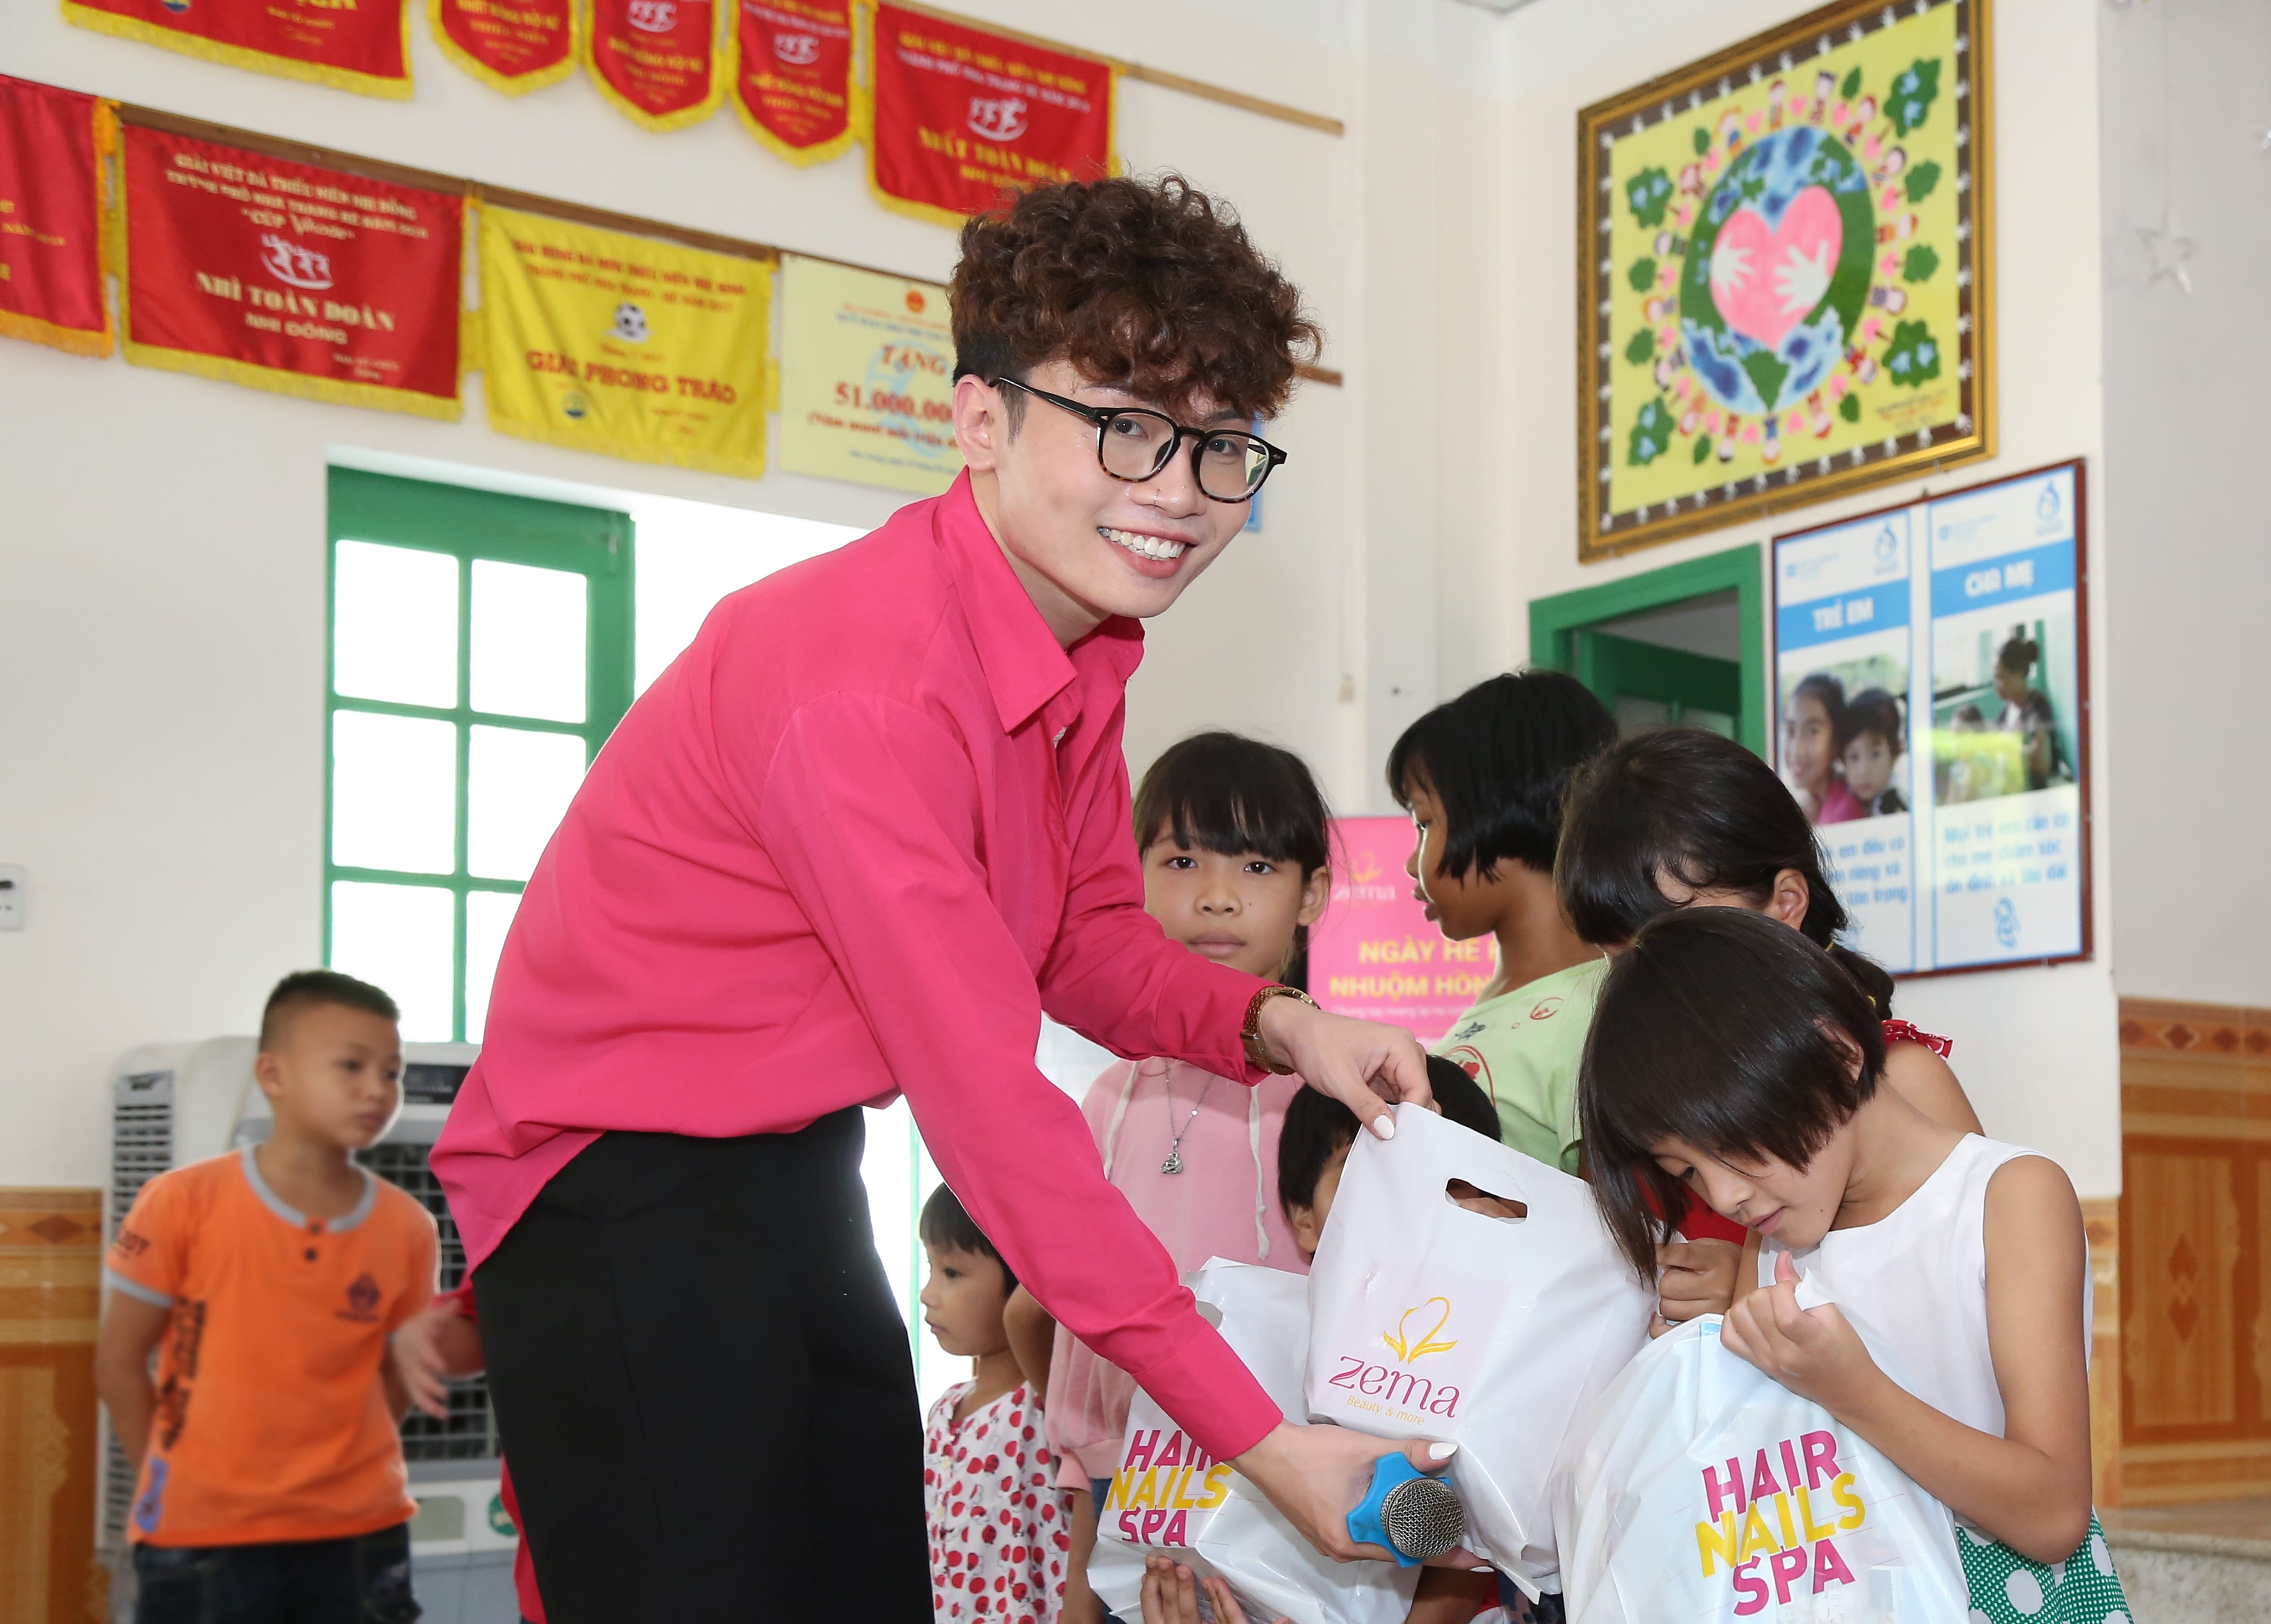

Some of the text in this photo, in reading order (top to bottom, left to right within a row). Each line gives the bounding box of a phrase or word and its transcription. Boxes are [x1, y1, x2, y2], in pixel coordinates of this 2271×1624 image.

[195, 270, 395, 331] NHÌ TOÀN ĐOÀN
[245, 313, 282, 333] NHI
[584, 362, 669, 393] PHONG
[677, 373, 738, 405] TRÀO
[1964, 560, 2034, 598] CHA MẸ
[1812, 596, 1875, 632] TRẺ EM
[1839, 844, 1858, 858] em
[1359, 934, 1435, 964] NGÀY
[1329, 968, 1491, 1002] NHUỘM HỒN
[1328, 1355, 1460, 1418] zema
[1347, 1395, 1425, 1425] Beauty & more
[1105, 1465, 1233, 1511] NAILS
[1701, 1430, 1841, 1524] HAIR
[1119, 1506, 1187, 1547] SPA
[1695, 1472, 1866, 1578] NAILS
[1733, 1538, 1856, 1616] SPA
